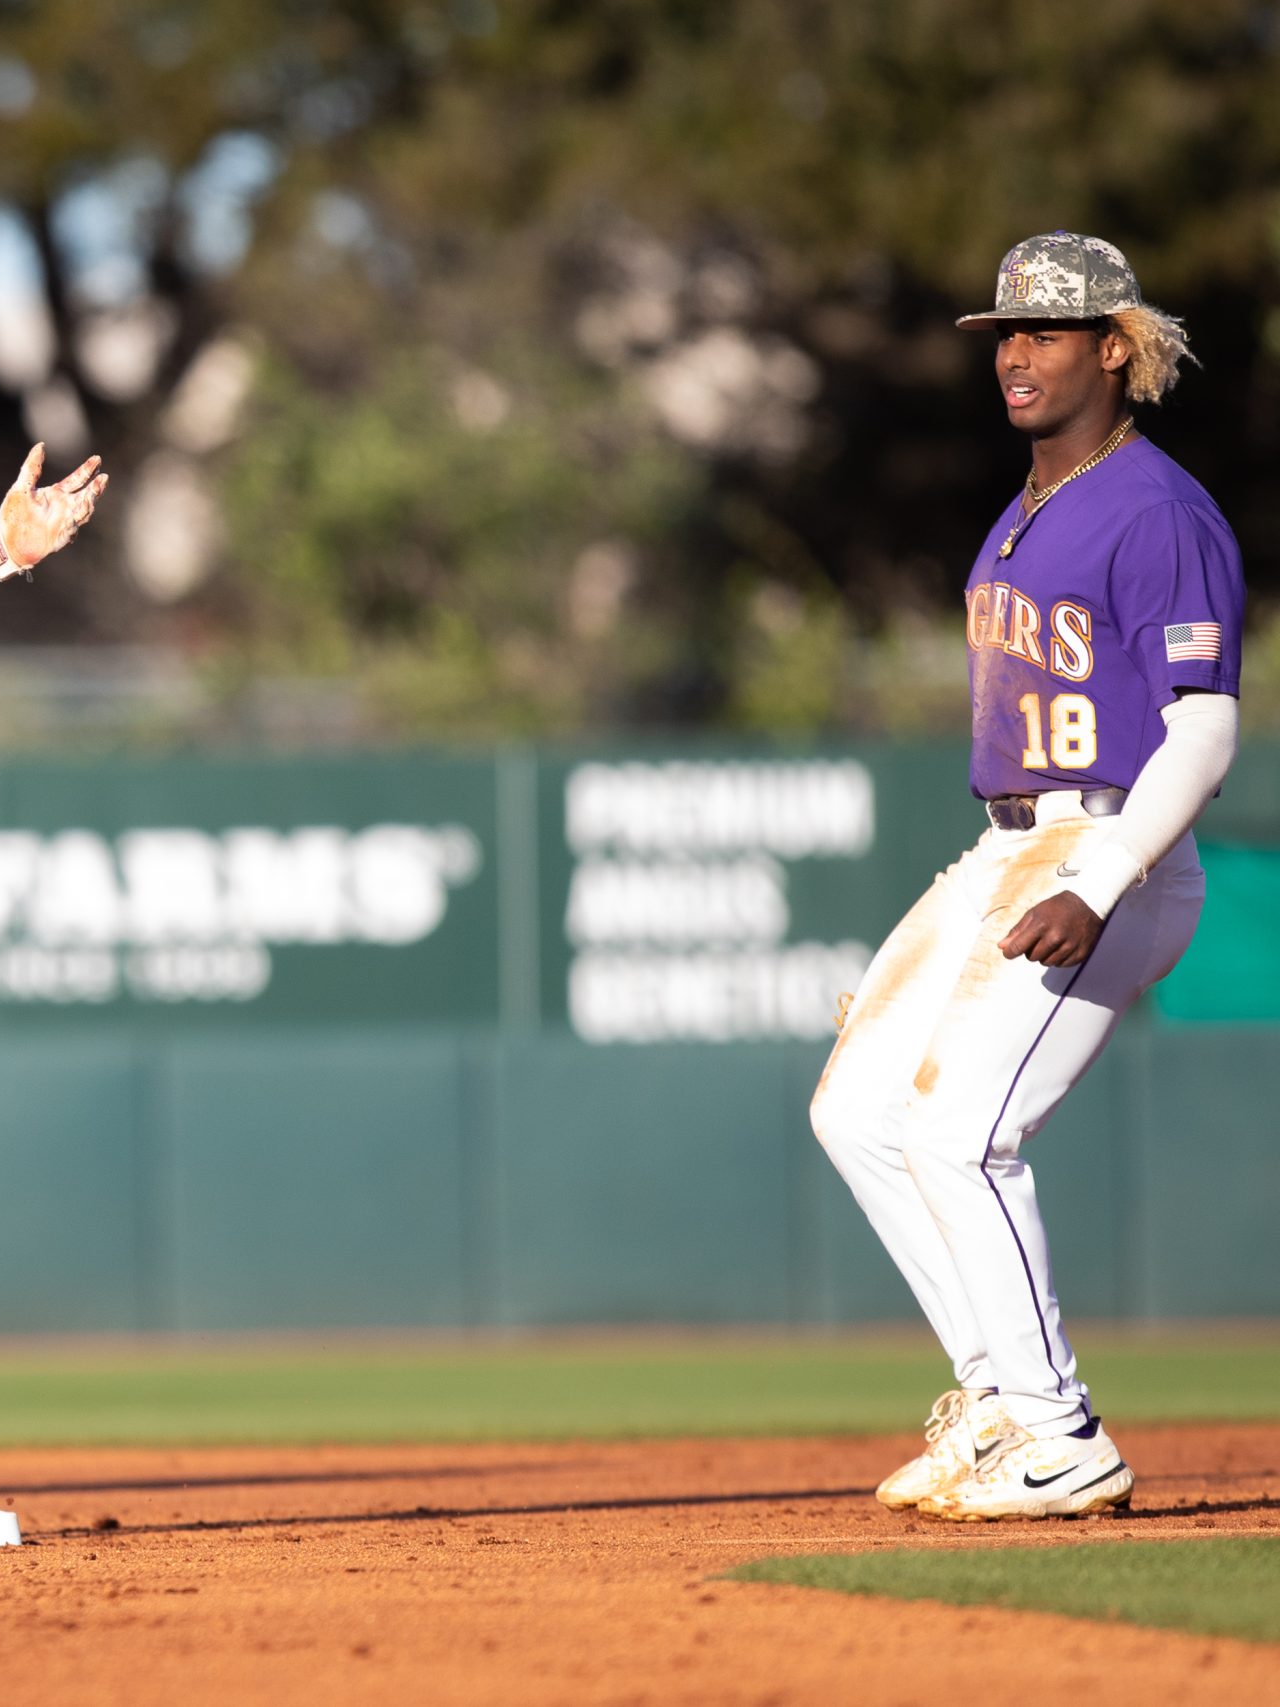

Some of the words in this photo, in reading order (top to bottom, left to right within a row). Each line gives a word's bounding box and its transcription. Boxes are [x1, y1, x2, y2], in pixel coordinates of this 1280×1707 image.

[965, 581, 1094, 682] GERS
[1019, 693, 1097, 768] 18
[567, 762, 873, 855] PREMIUM
